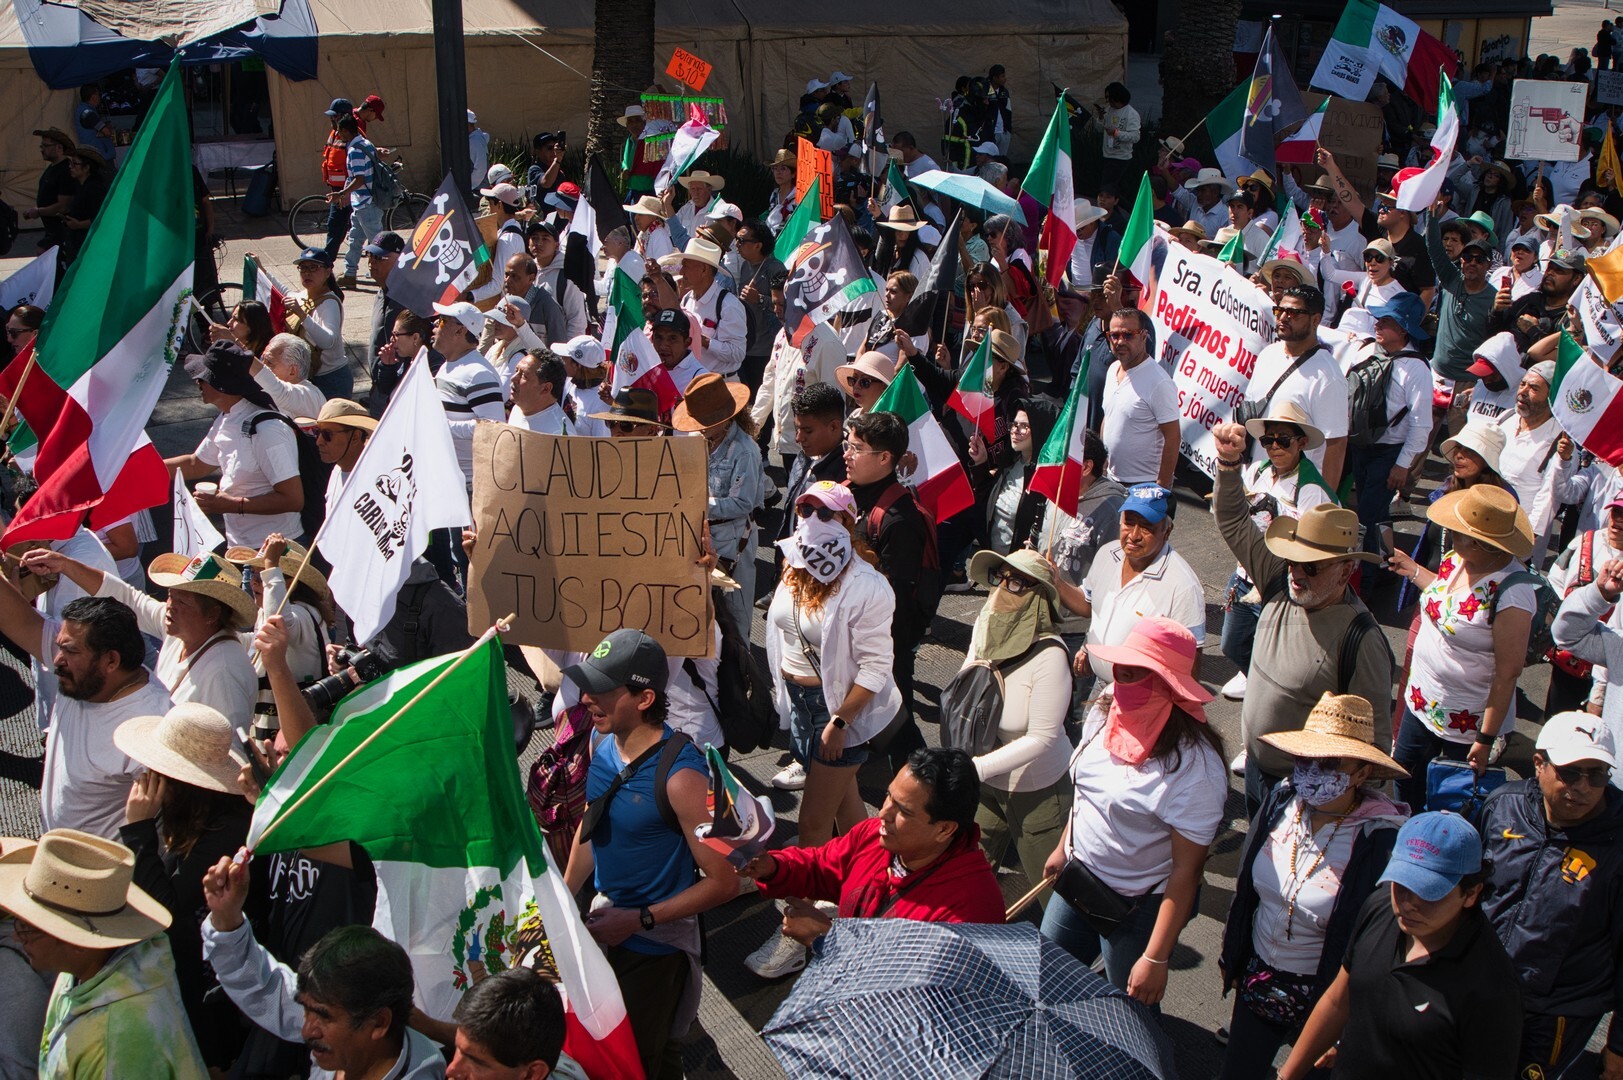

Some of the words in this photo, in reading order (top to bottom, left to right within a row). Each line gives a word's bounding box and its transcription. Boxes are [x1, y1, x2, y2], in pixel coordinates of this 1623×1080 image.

[1173, 258, 1203, 297] Sra.
[1156, 289, 1231, 360] Pedimos
[1228, 338, 1259, 380] Jus
[1161, 339, 1180, 367] por
[1179, 350, 1197, 379] la
[491, 429, 682, 500] CLAUDIA
[487, 507, 589, 560] AQUI
[597, 502, 706, 557] ESTÁN
[797, 543, 836, 577] NZO
[821, 538, 846, 566] RA
[501, 571, 588, 629] TUS
[599, 578, 703, 641] BOTS
[631, 673, 651, 685] STAFF
